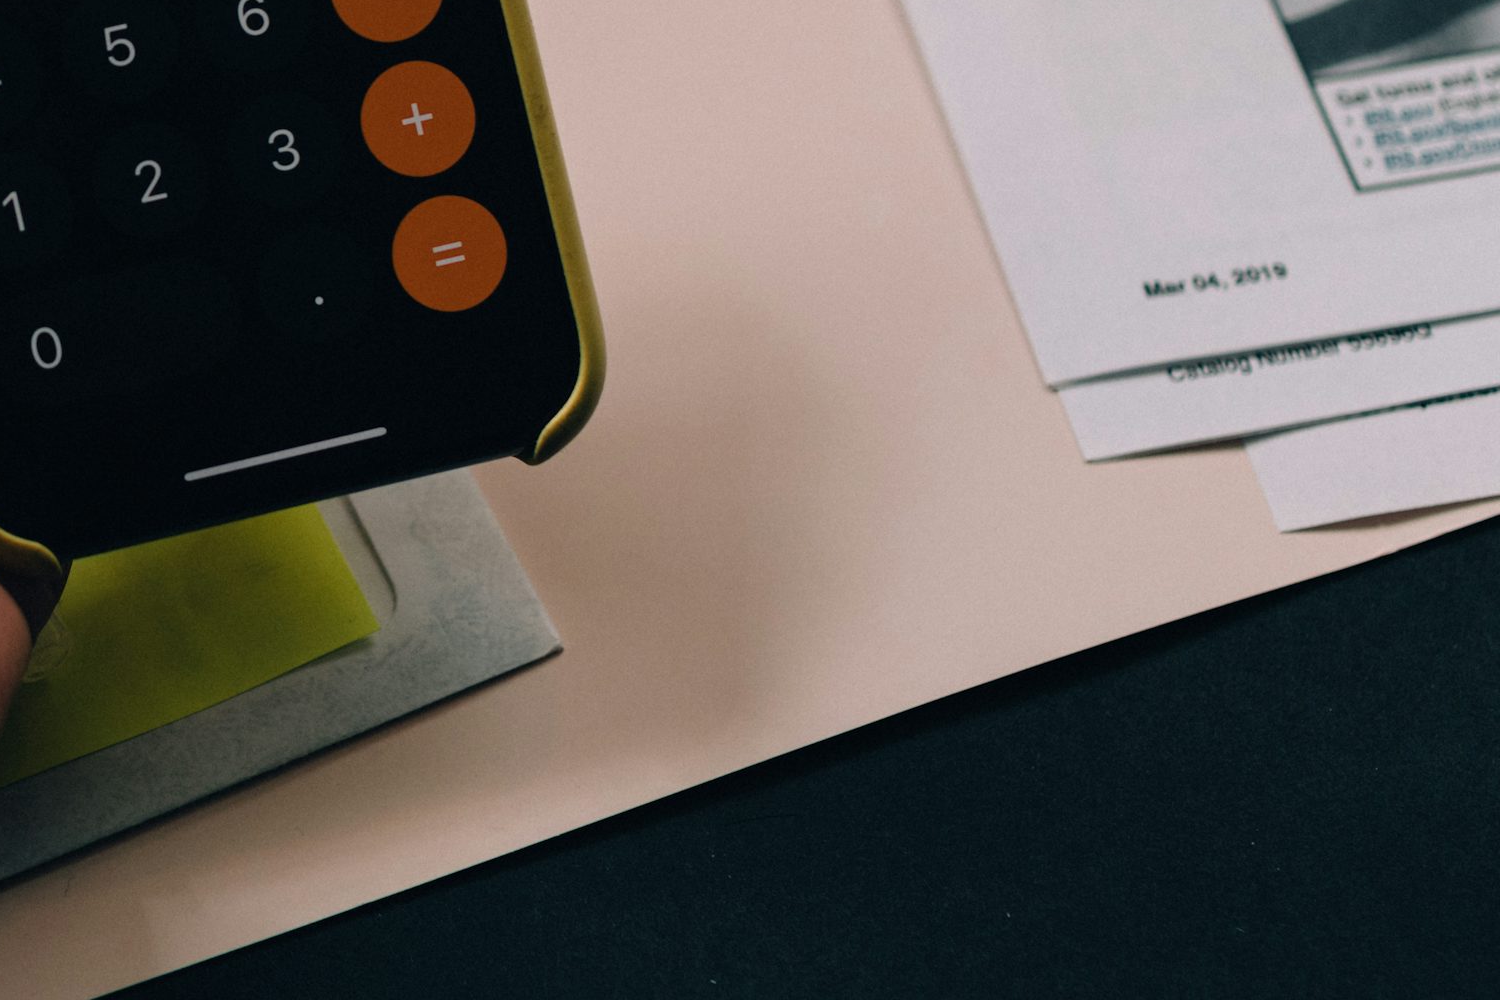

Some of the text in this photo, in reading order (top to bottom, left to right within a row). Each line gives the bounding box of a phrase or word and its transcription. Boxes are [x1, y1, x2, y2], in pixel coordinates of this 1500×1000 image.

[103, 22, 137, 68] 5
[1, 102, 433, 233] 1 2 3 +
[30, 325, 64, 370] 0
[431, 240, 467, 268] =
[1143, 262, 1288, 297] Mar 04, 2019
